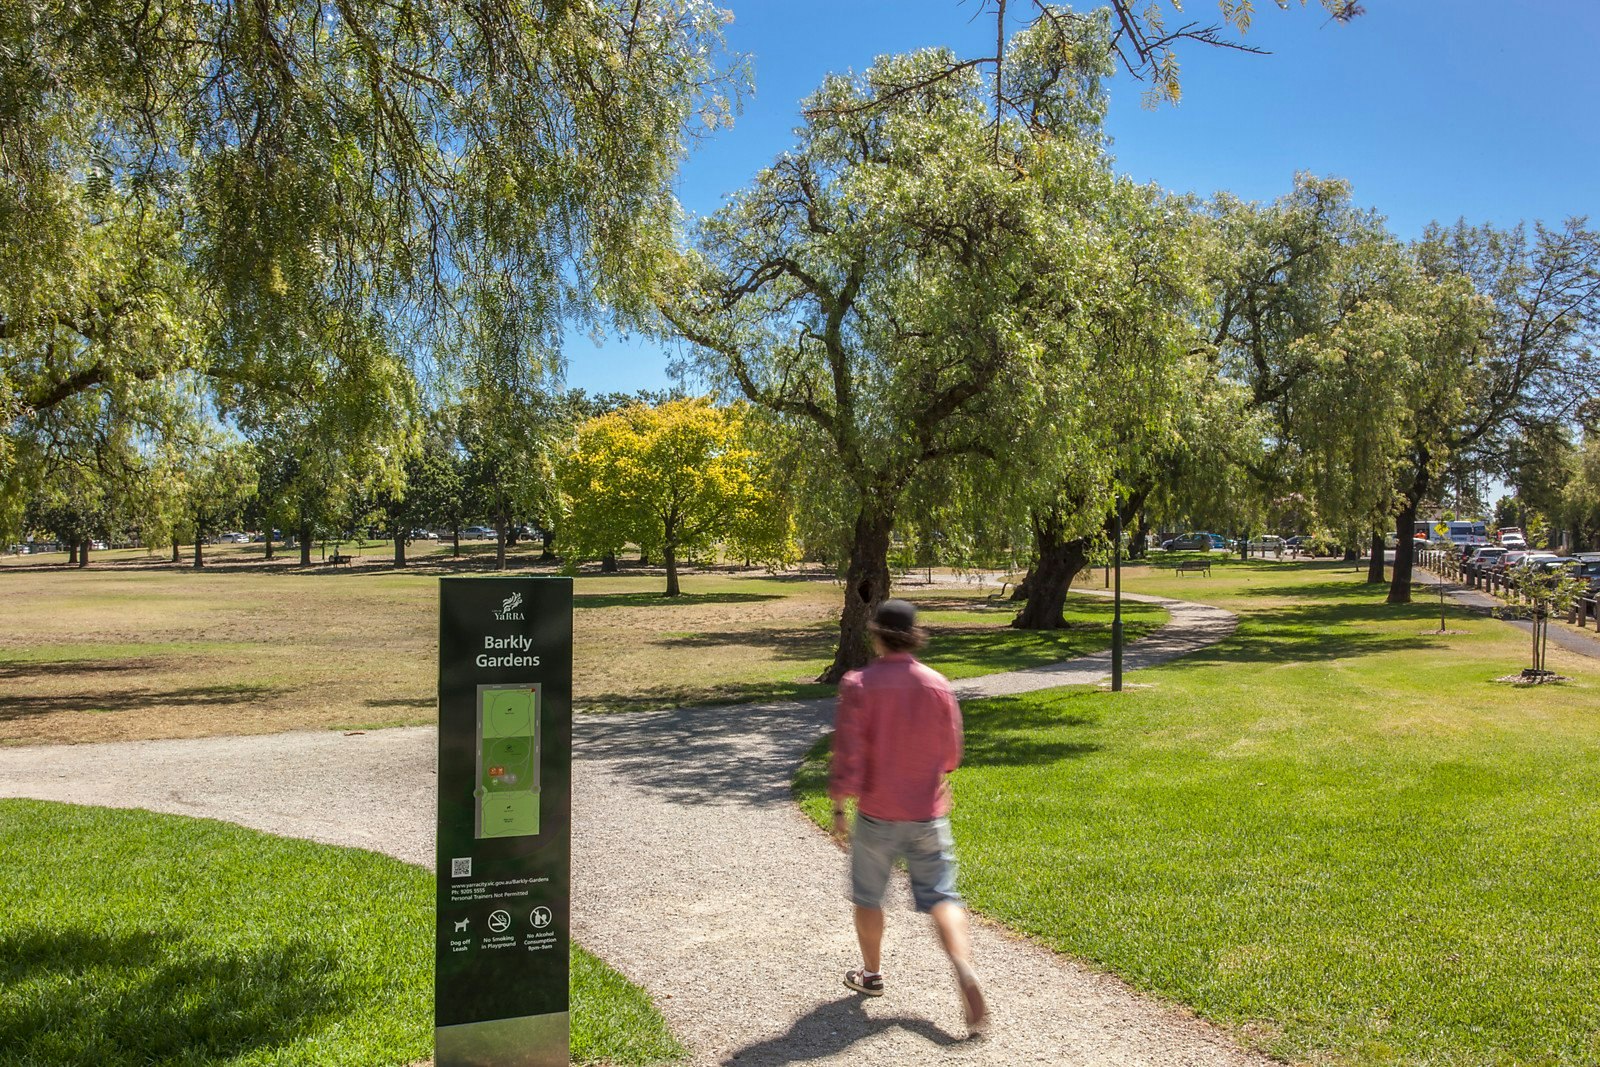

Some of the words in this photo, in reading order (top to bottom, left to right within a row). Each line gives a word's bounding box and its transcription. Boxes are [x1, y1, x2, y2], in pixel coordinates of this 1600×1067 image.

[484, 635, 533, 652] Barkly
[475, 654, 540, 668] Gardens
[488, 941, 516, 949] Playground
[524, 938, 557, 946] Consumption
